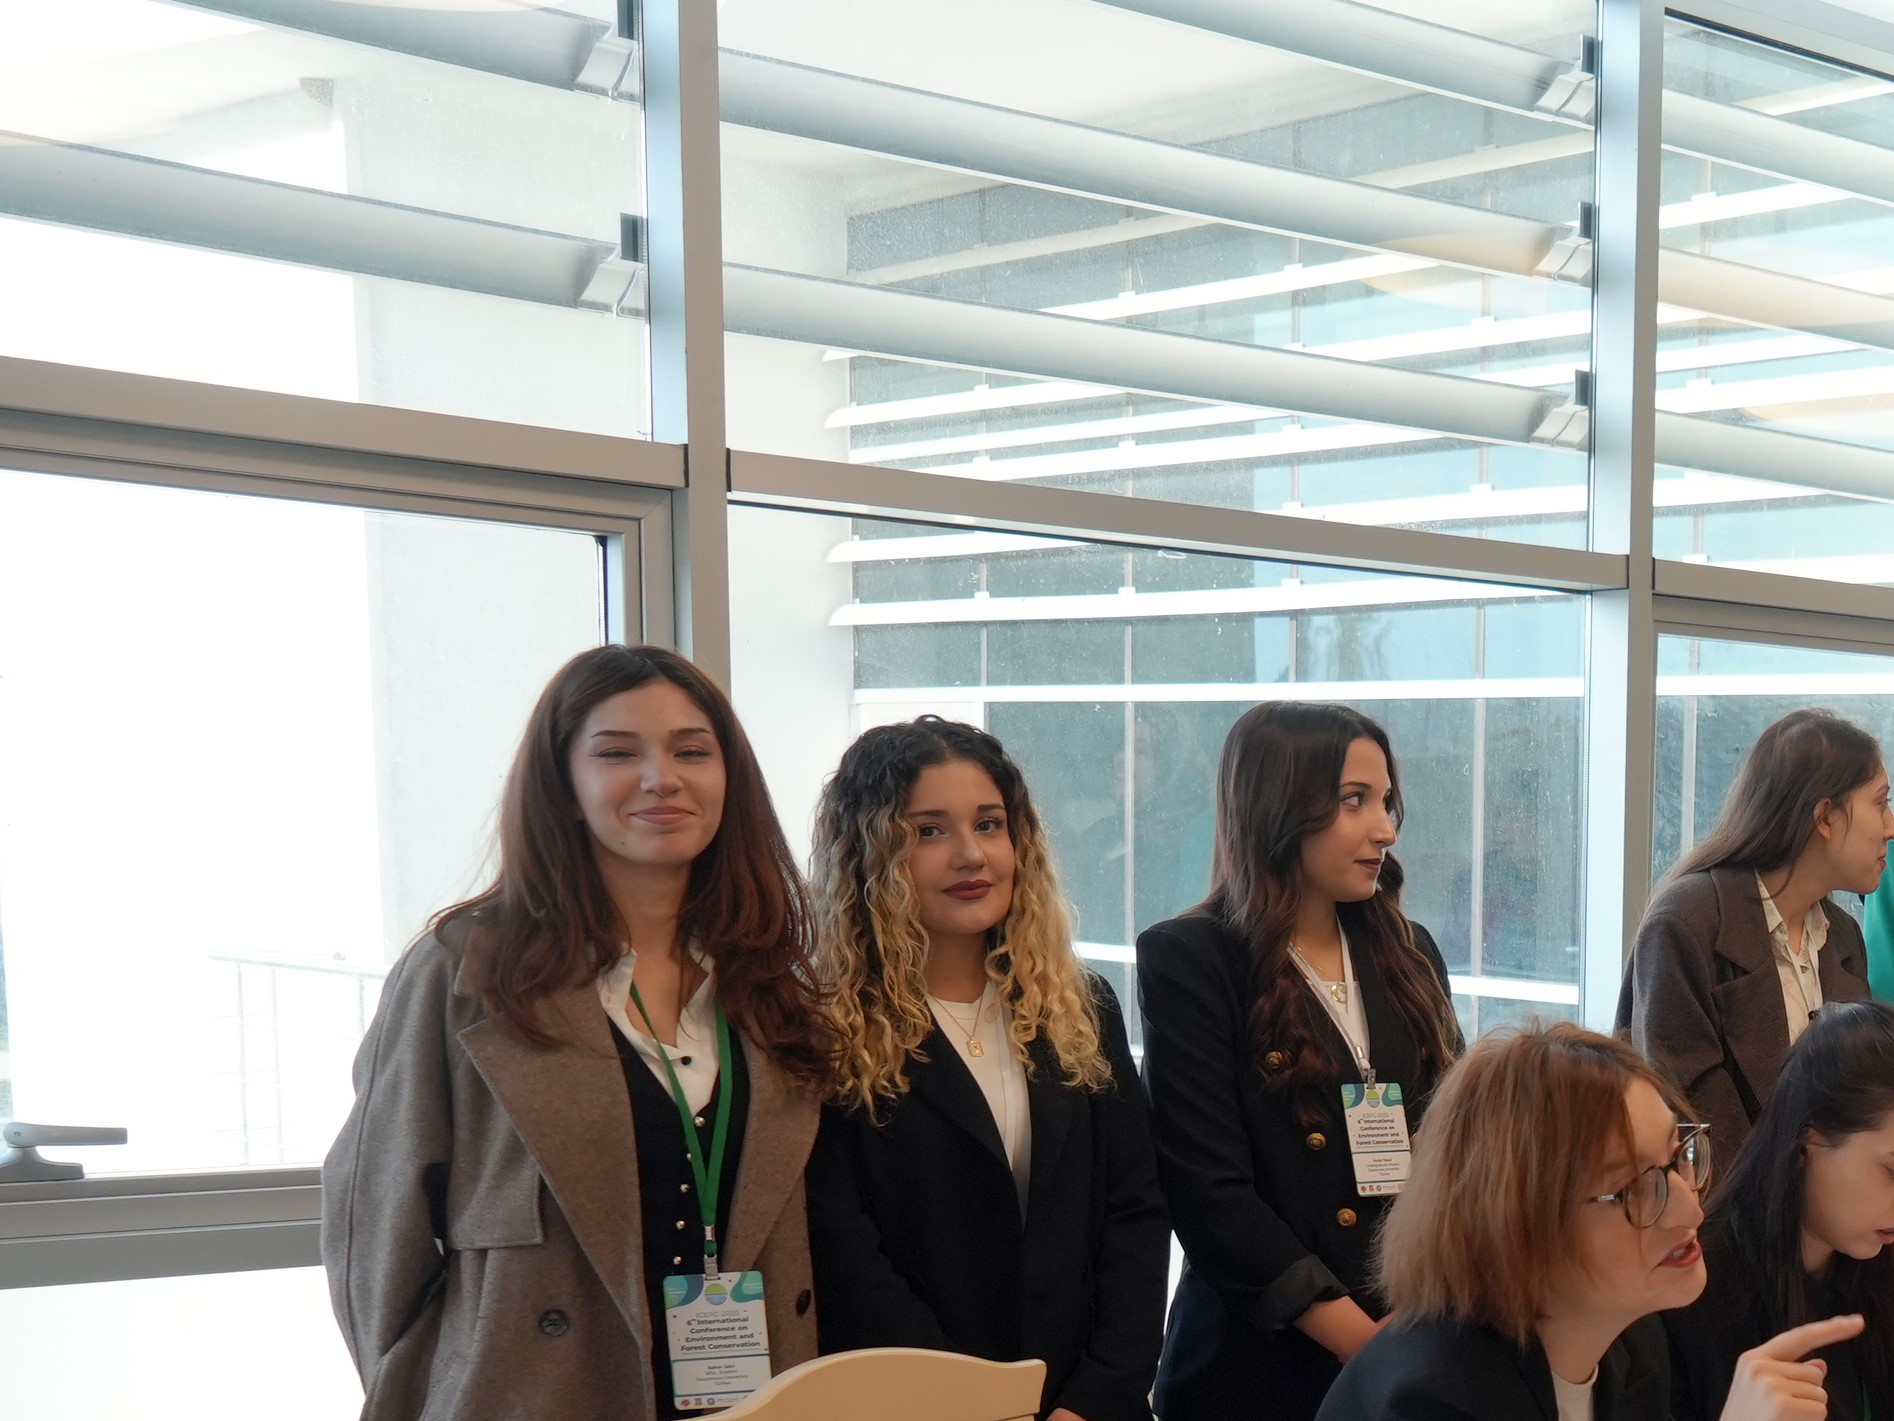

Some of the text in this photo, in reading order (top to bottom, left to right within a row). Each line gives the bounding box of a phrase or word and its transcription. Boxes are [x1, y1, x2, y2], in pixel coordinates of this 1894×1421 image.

[696, 1316, 750, 1326] International
[690, 1326, 736, 1334] Conference
[685, 1332, 755, 1343] Environment and
[707, 1341, 761, 1350] Conservation
